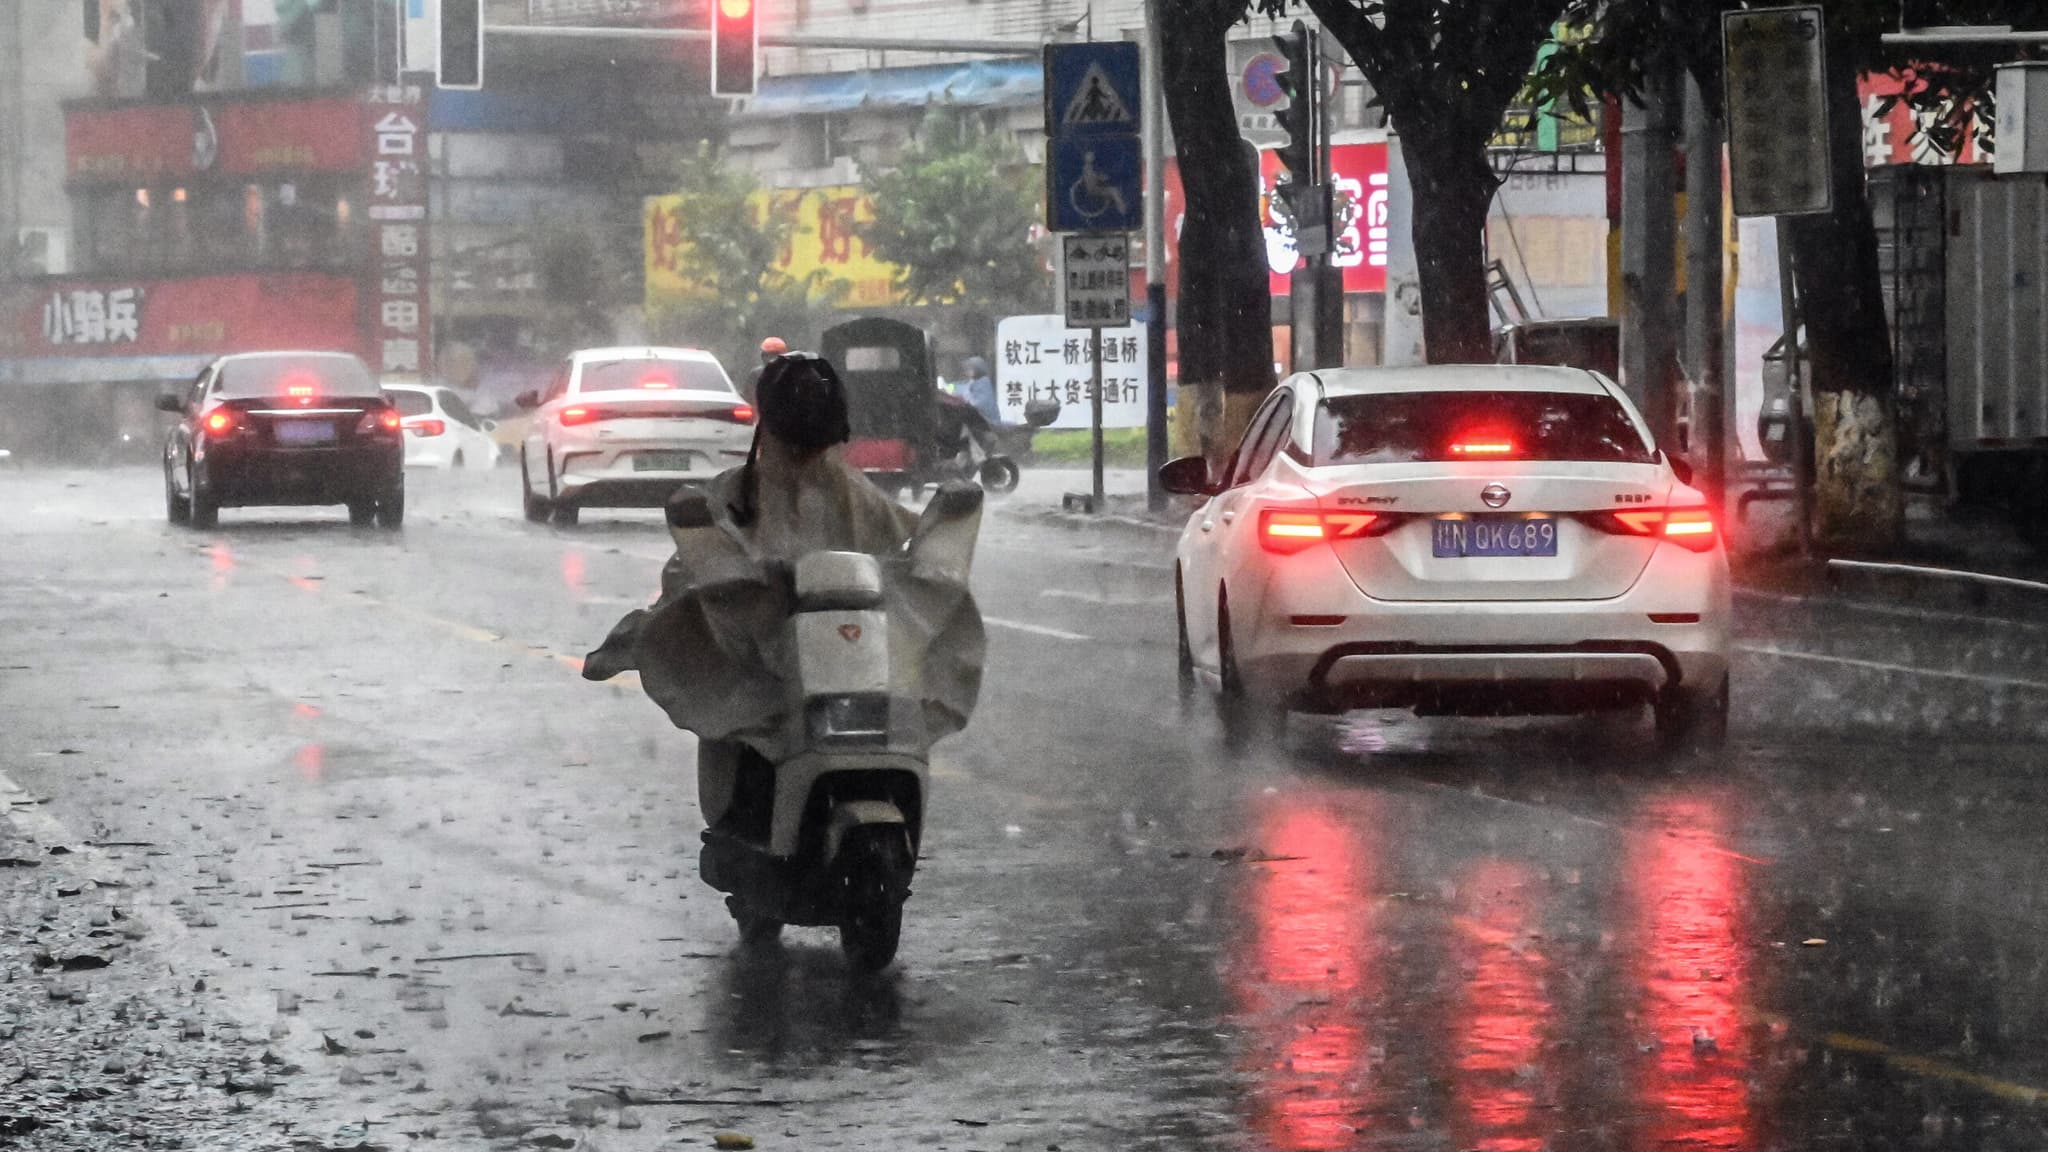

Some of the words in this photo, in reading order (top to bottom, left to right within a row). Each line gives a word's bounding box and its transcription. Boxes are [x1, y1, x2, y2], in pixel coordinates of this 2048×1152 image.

[43, 287, 139, 344] 小骑兵
[1006, 378, 1139, 406] 禁止大货车通行
